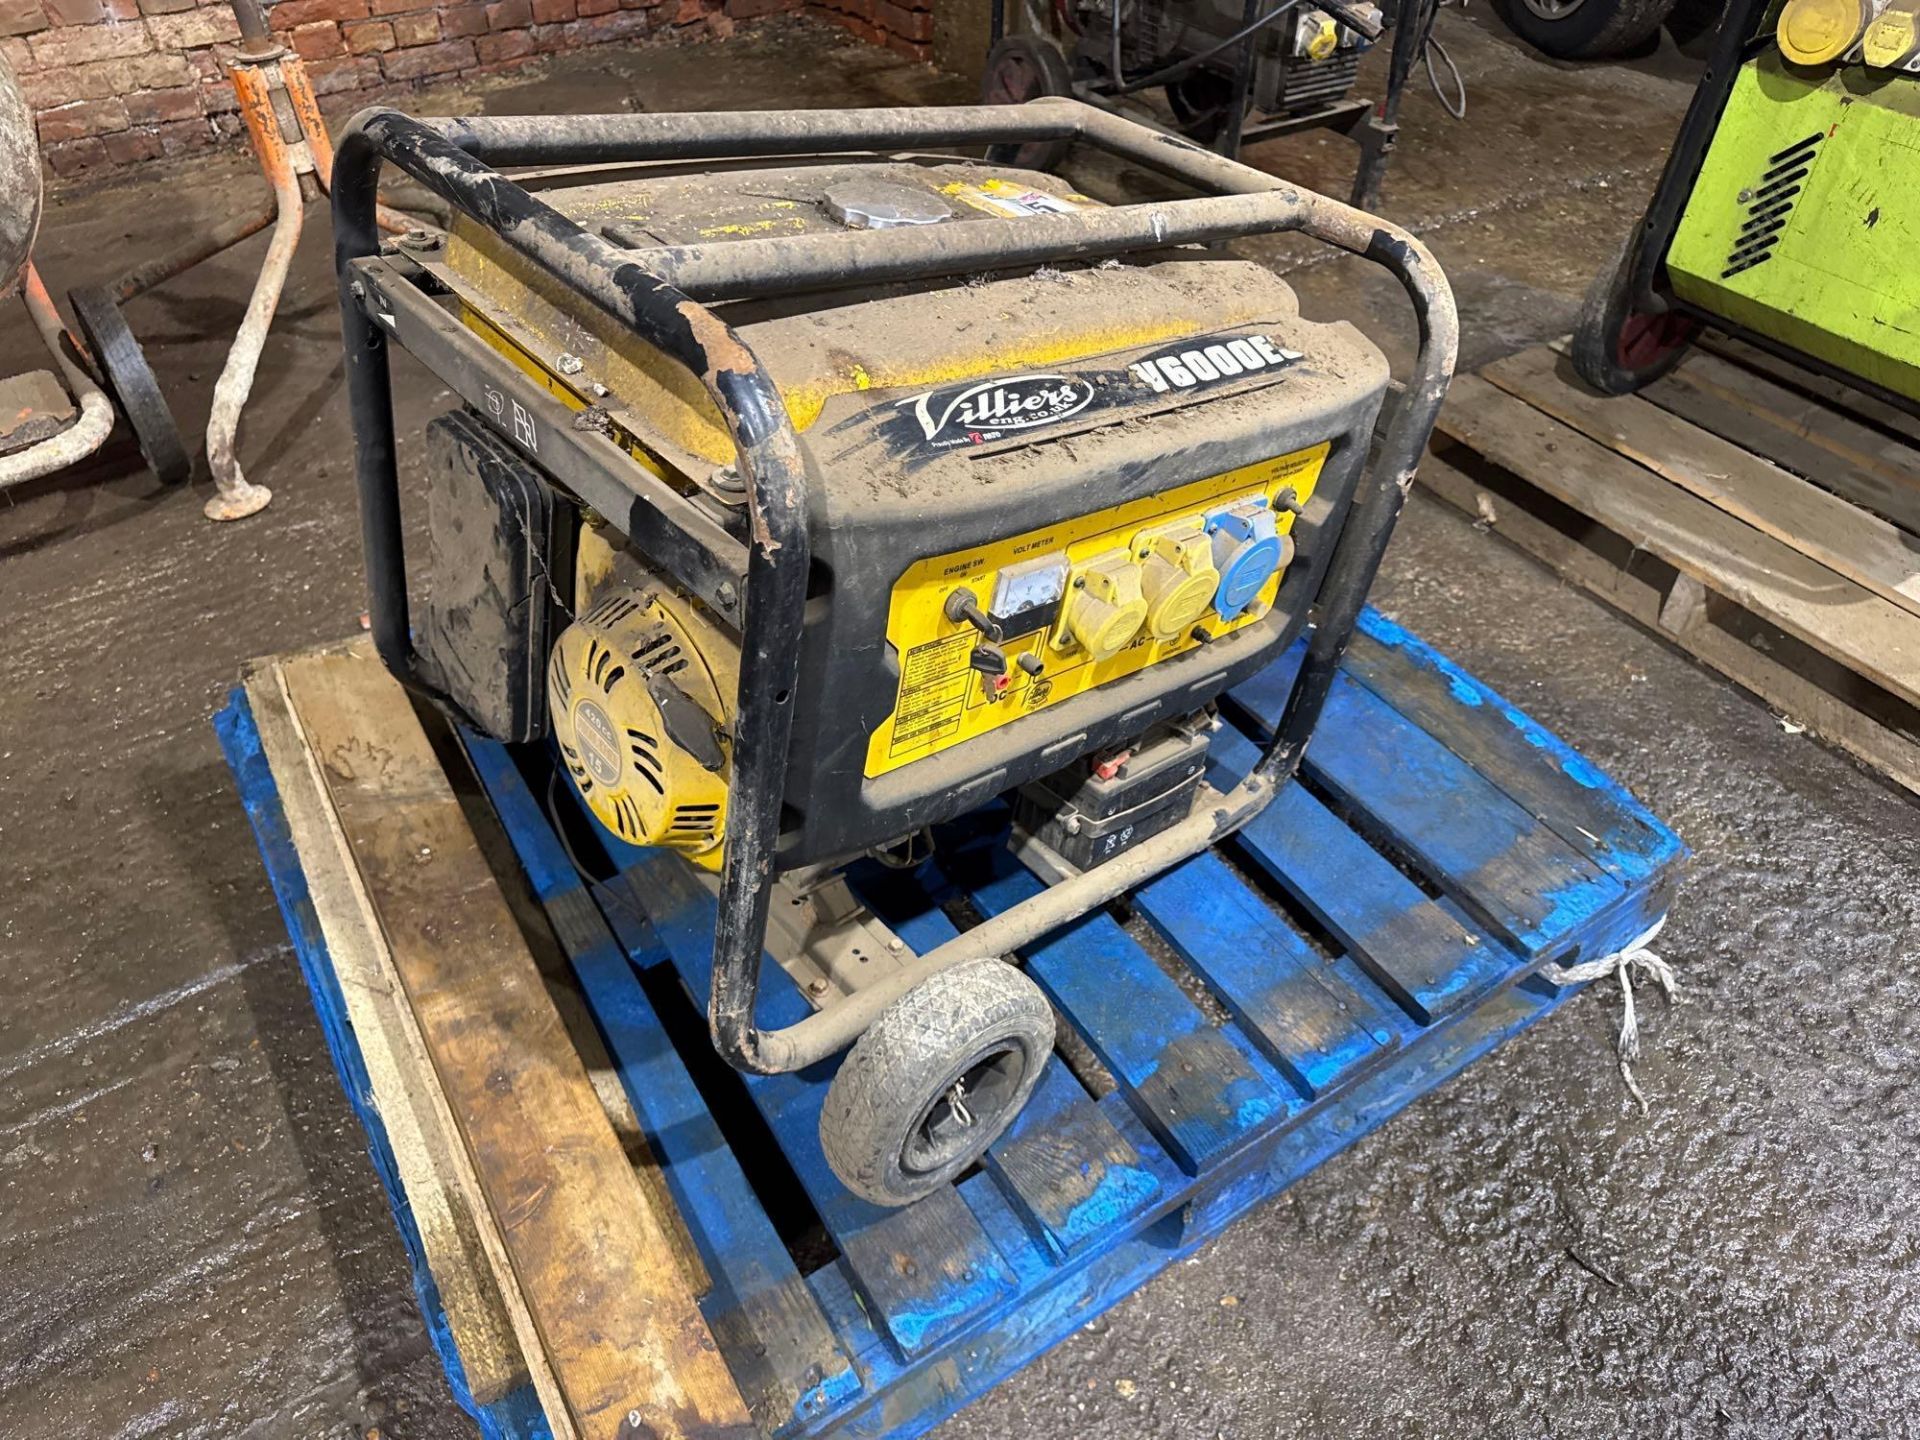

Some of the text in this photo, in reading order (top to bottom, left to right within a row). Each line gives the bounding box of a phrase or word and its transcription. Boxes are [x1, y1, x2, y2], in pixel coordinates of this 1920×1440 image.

[896, 376, 1084, 440] Villiers
[989, 401, 1073, 426] eng.co.uk
[1013, 536, 1054, 555] VOLT METER
[943, 558, 985, 576] ENGINE SW
[1129, 637, 1145, 650] AC
[584, 708, 602, 729] 420
